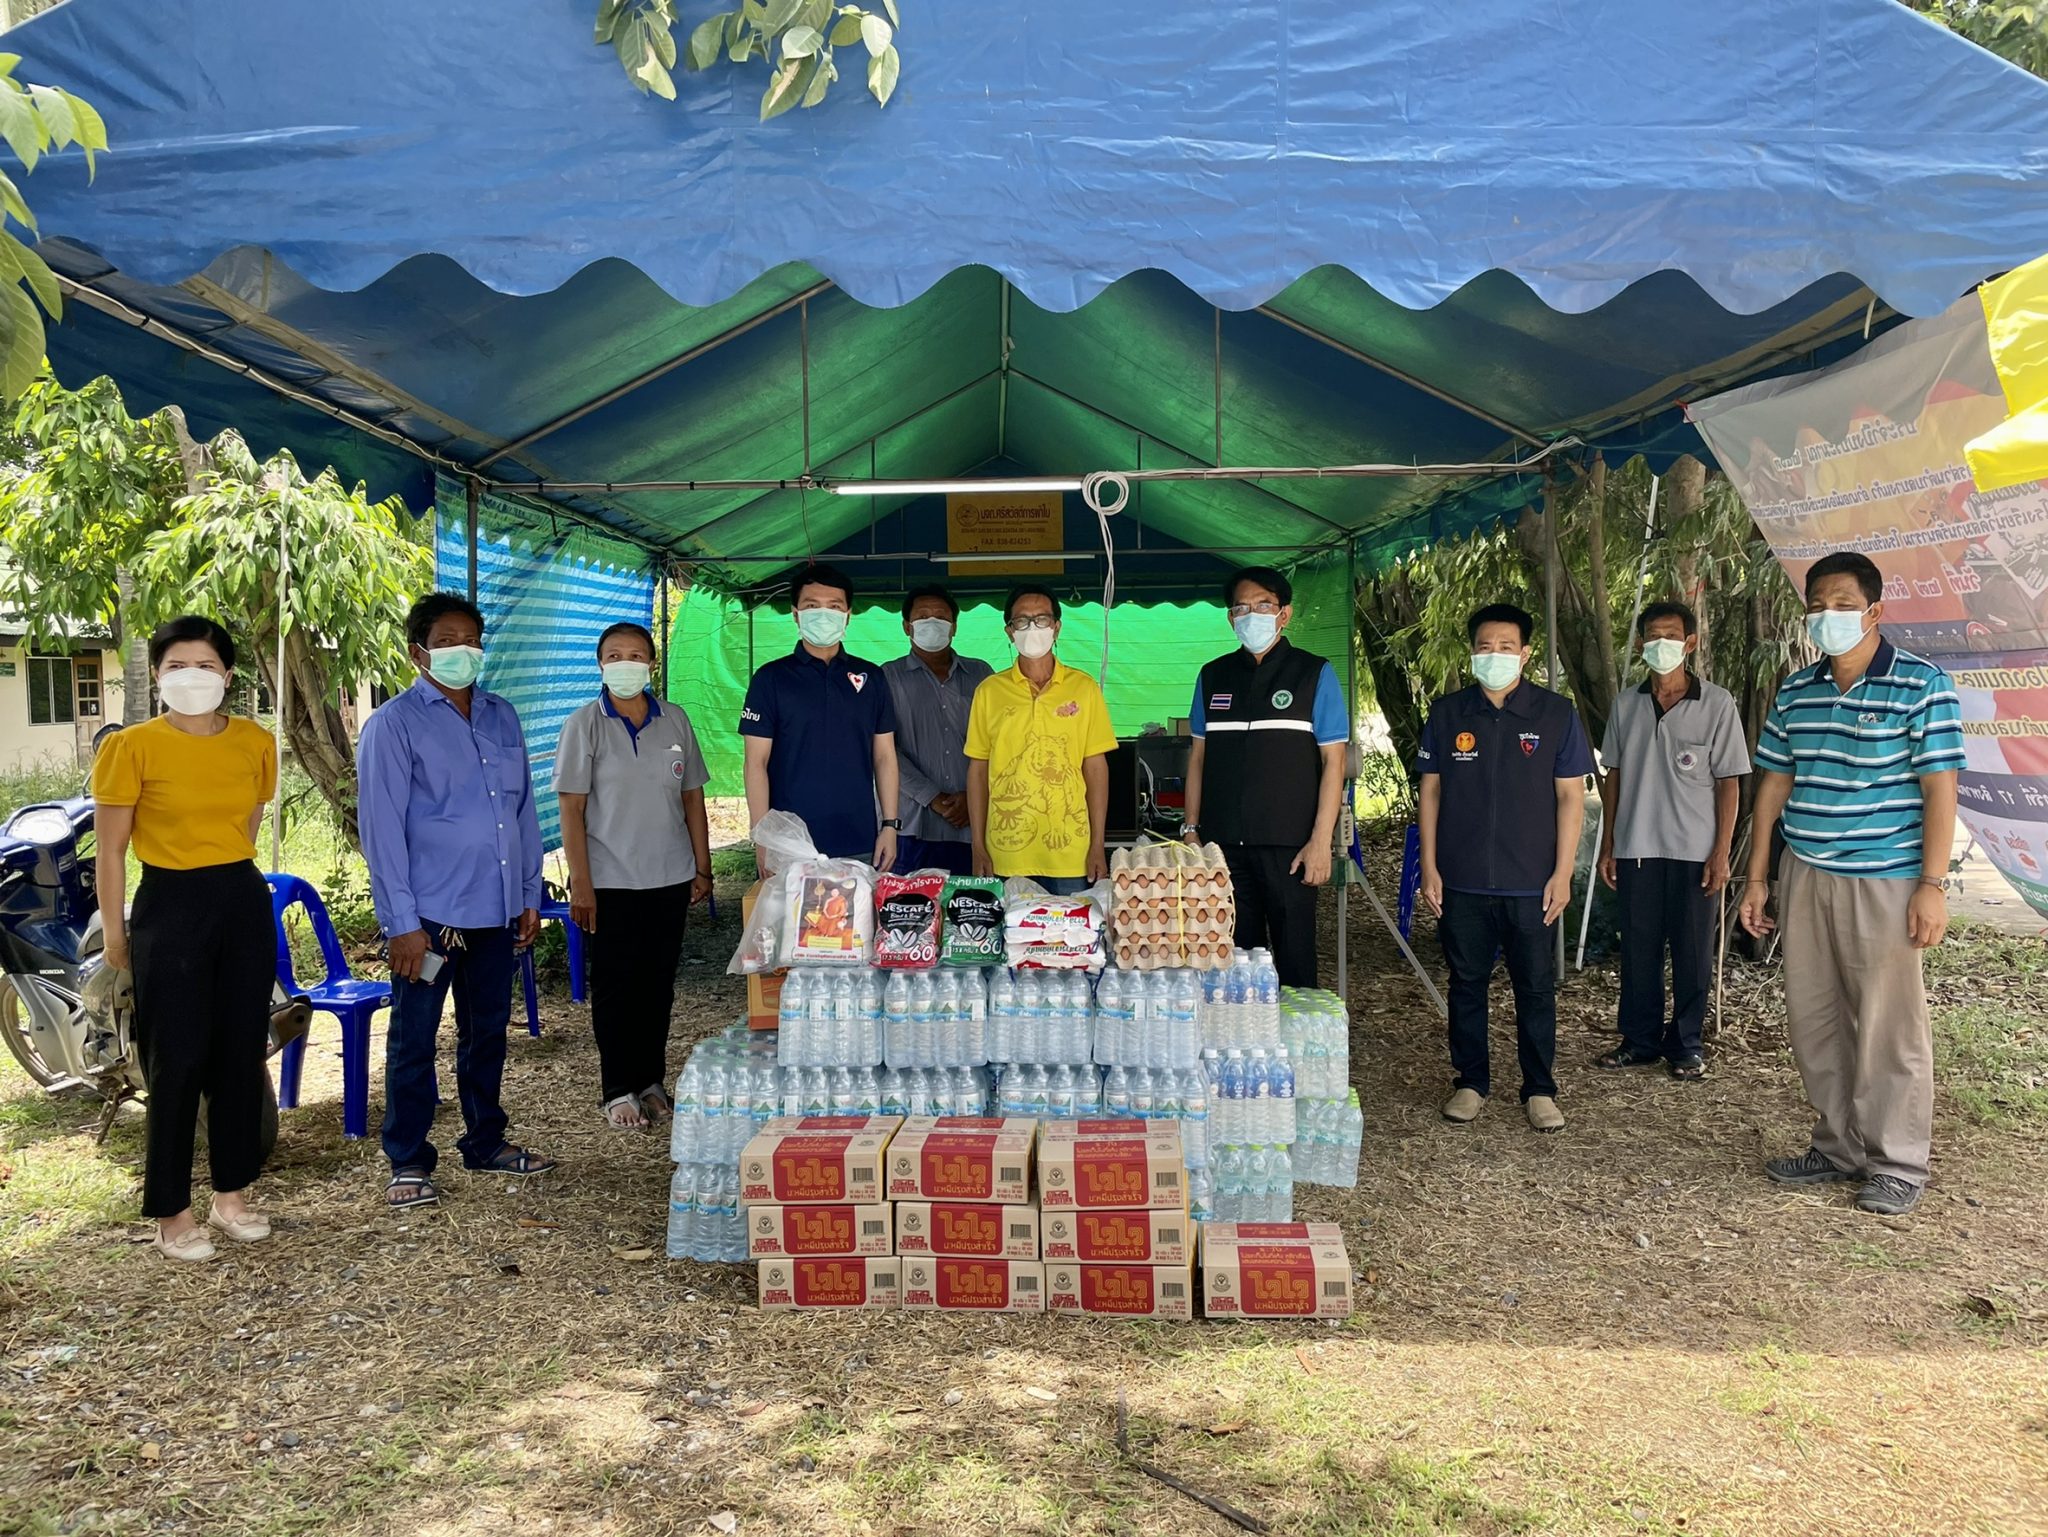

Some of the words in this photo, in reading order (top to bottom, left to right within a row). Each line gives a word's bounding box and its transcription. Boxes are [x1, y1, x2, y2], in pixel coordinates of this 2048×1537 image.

[909, 945, 933, 962] 60
[980, 938, 1002, 955] 60
[780, 1158, 839, 1186] ไวไว
[928, 1155, 986, 1184] ไวไว
[1081, 1163, 1142, 1191] ไวไว
[791, 1211, 849, 1240] ไวไว
[938, 1211, 996, 1240] ไวไว
[1084, 1217, 1144, 1246] ไวไว
[800, 1263, 859, 1291] ไวไว
[943, 1265, 1002, 1293] ไวไว
[1088, 1269, 1148, 1298] ไวไว
[1247, 1270, 1309, 1299] ไวไว
